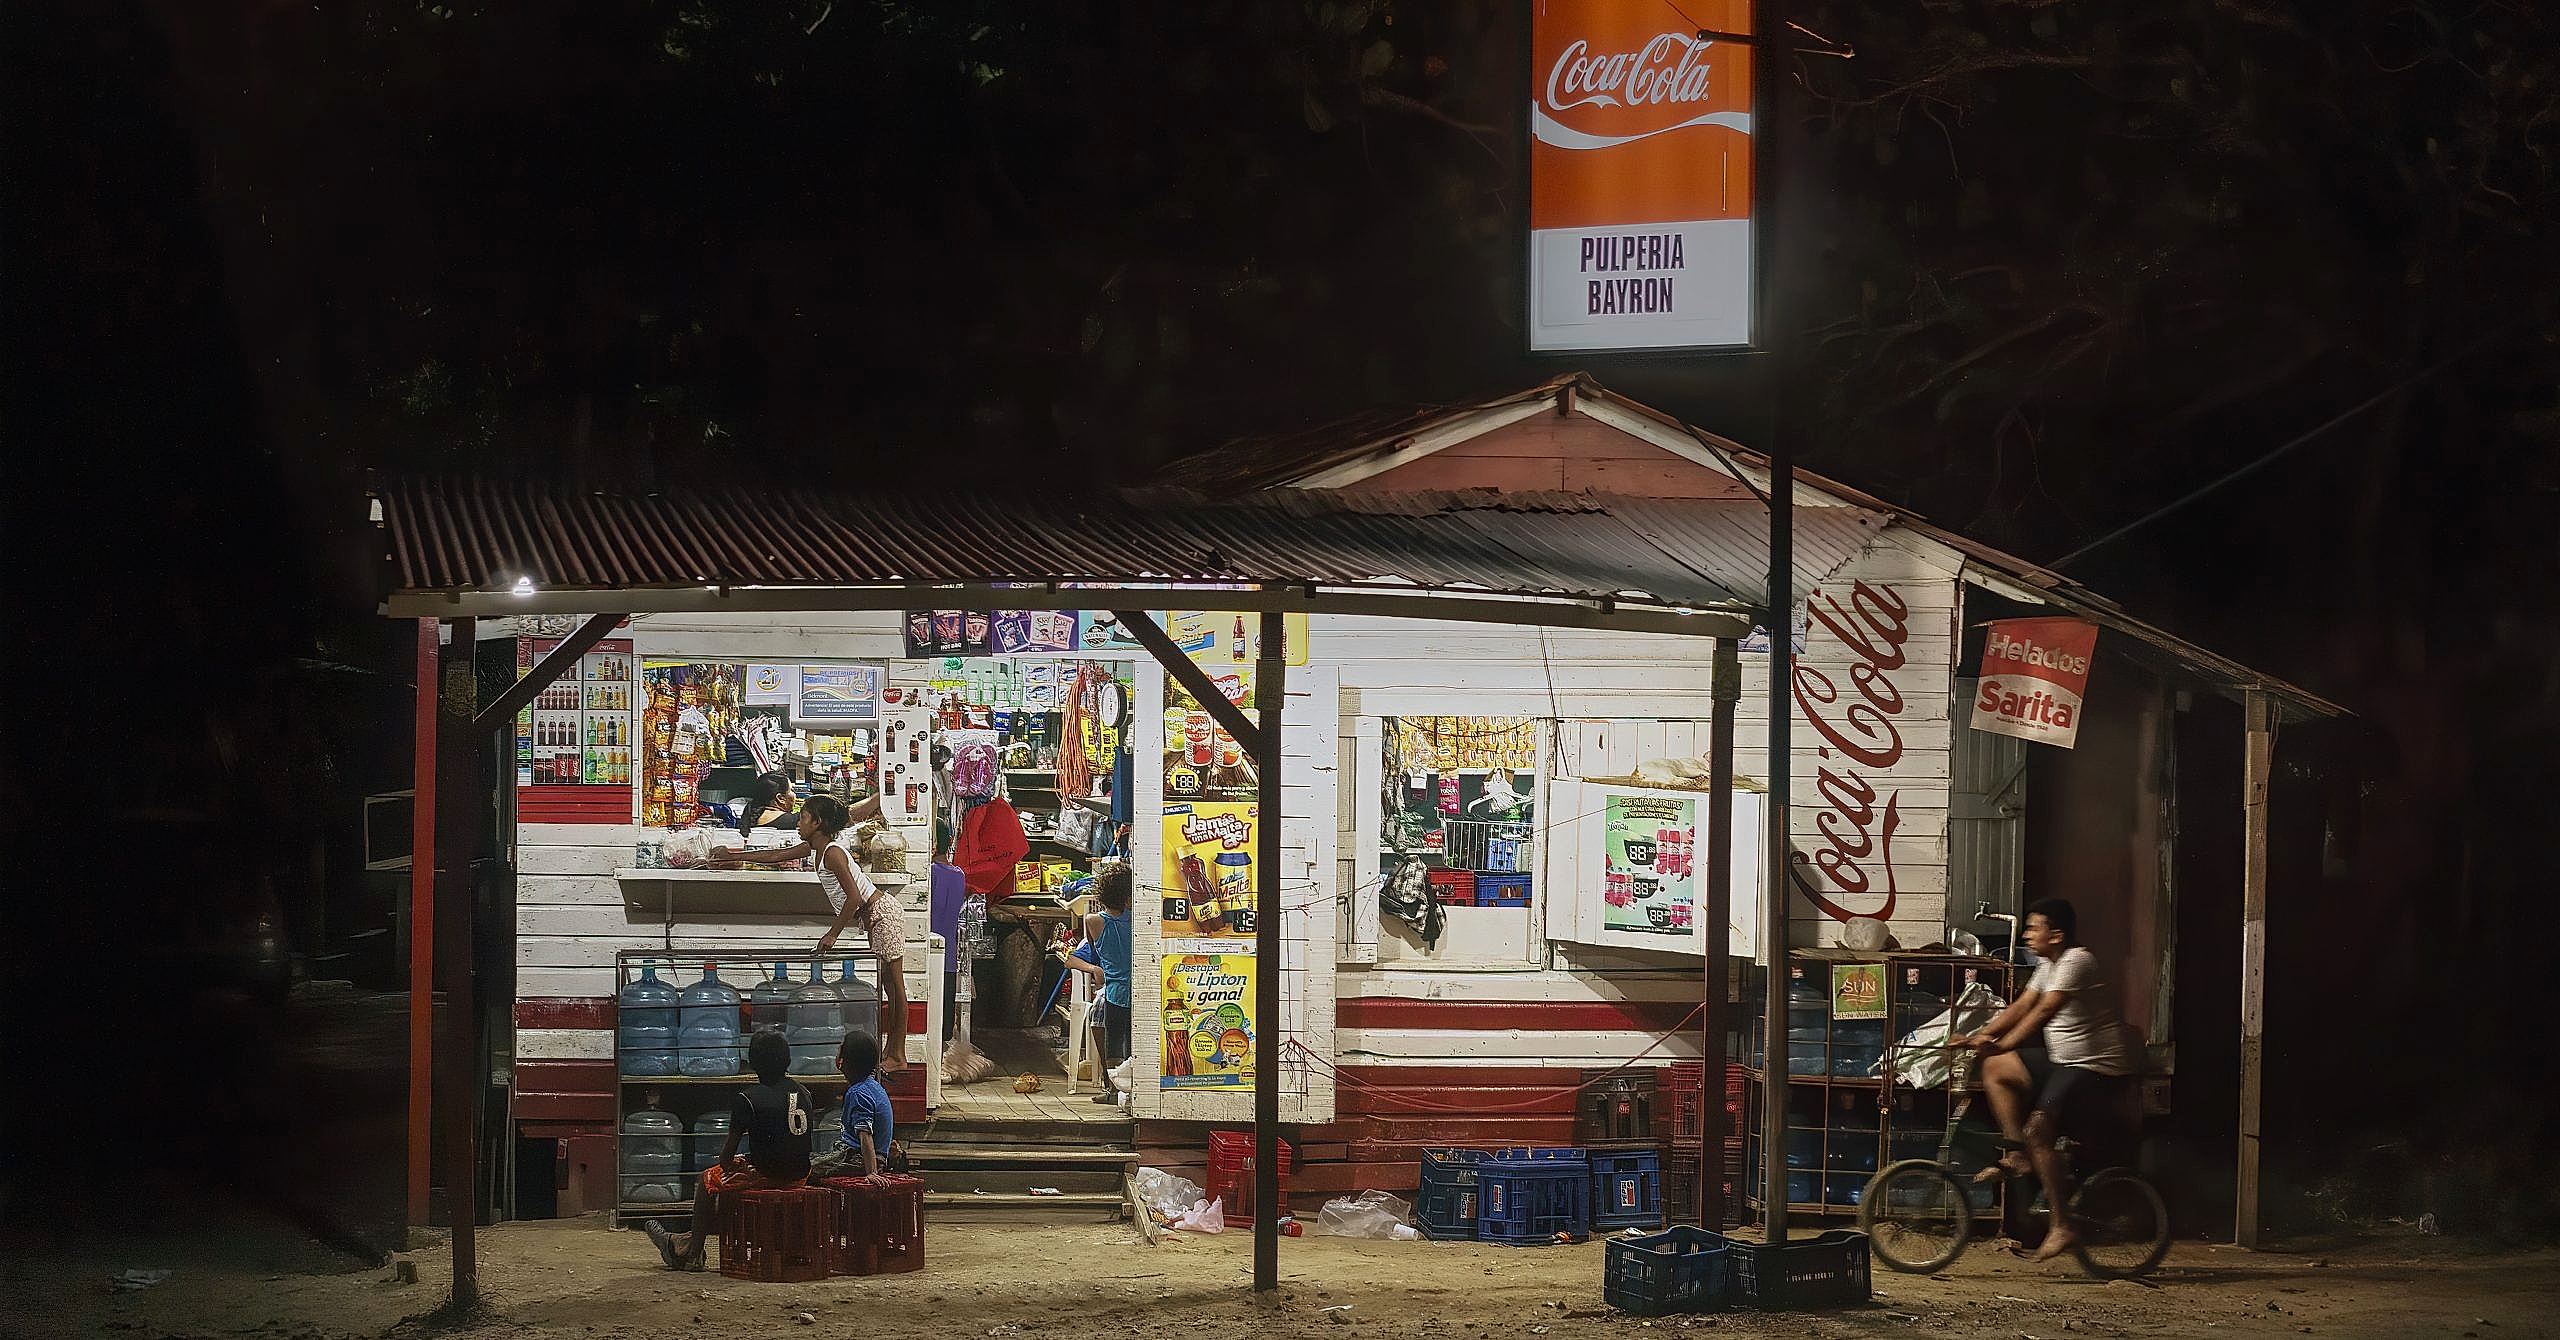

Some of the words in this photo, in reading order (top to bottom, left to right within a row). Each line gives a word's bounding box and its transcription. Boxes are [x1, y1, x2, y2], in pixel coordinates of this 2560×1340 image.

[1547, 32, 1713, 111] Coca-Cola
[1580, 234, 1685, 272] PULPERIA
[1587, 277, 1673, 316] BAYRON
[1988, 632, 2087, 675] Helados
[1978, 680, 2073, 728] Sarita
[1182, 813, 1236, 835] Jamás
[1207, 822, 1243, 840] Malta
[1219, 880, 1250, 900] Malta
[1173, 963, 1220, 975] ¡Destapa
[1186, 976, 1197, 984] tu
[1197, 972, 1248, 991] Lipton
[1843, 979, 1876, 993] SUN
[1186, 990, 1196, 1002] y
[1196, 987, 1244, 1006] gana!
[787, 1092, 808, 1136] 6
